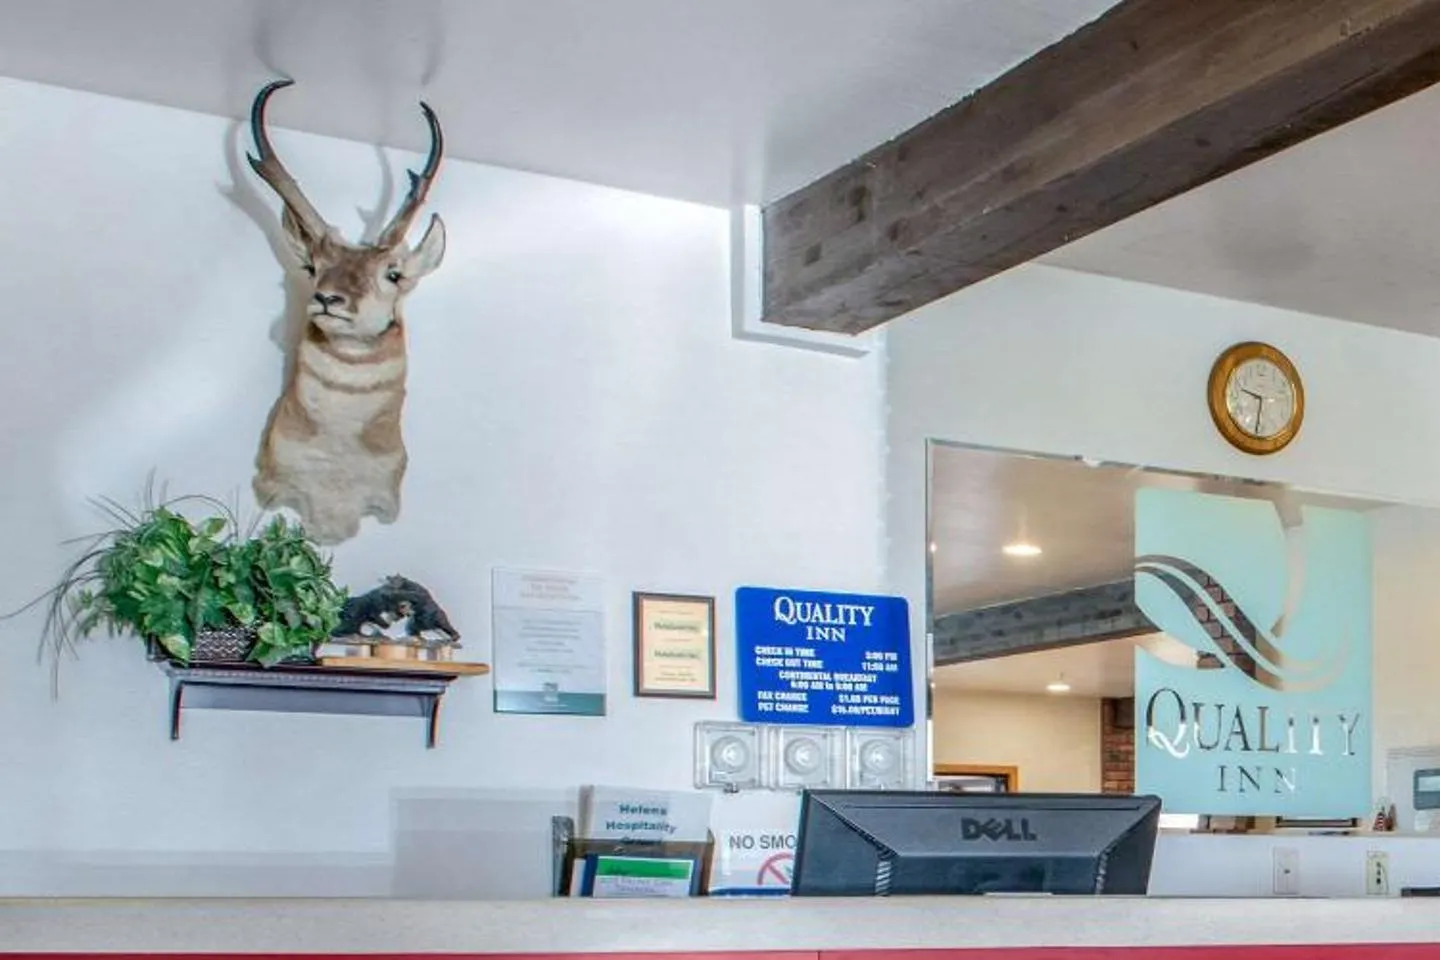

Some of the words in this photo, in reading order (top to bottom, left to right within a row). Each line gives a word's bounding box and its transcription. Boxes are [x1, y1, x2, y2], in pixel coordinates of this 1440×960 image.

[774, 597, 874, 626] QUALITY
[806, 626, 846, 642] INN
[1146, 687, 1360, 759] QUALITY
[1217, 764, 1297, 793] INN
[730, 834, 755, 850] NO
[961, 817, 1038, 841] DELL
